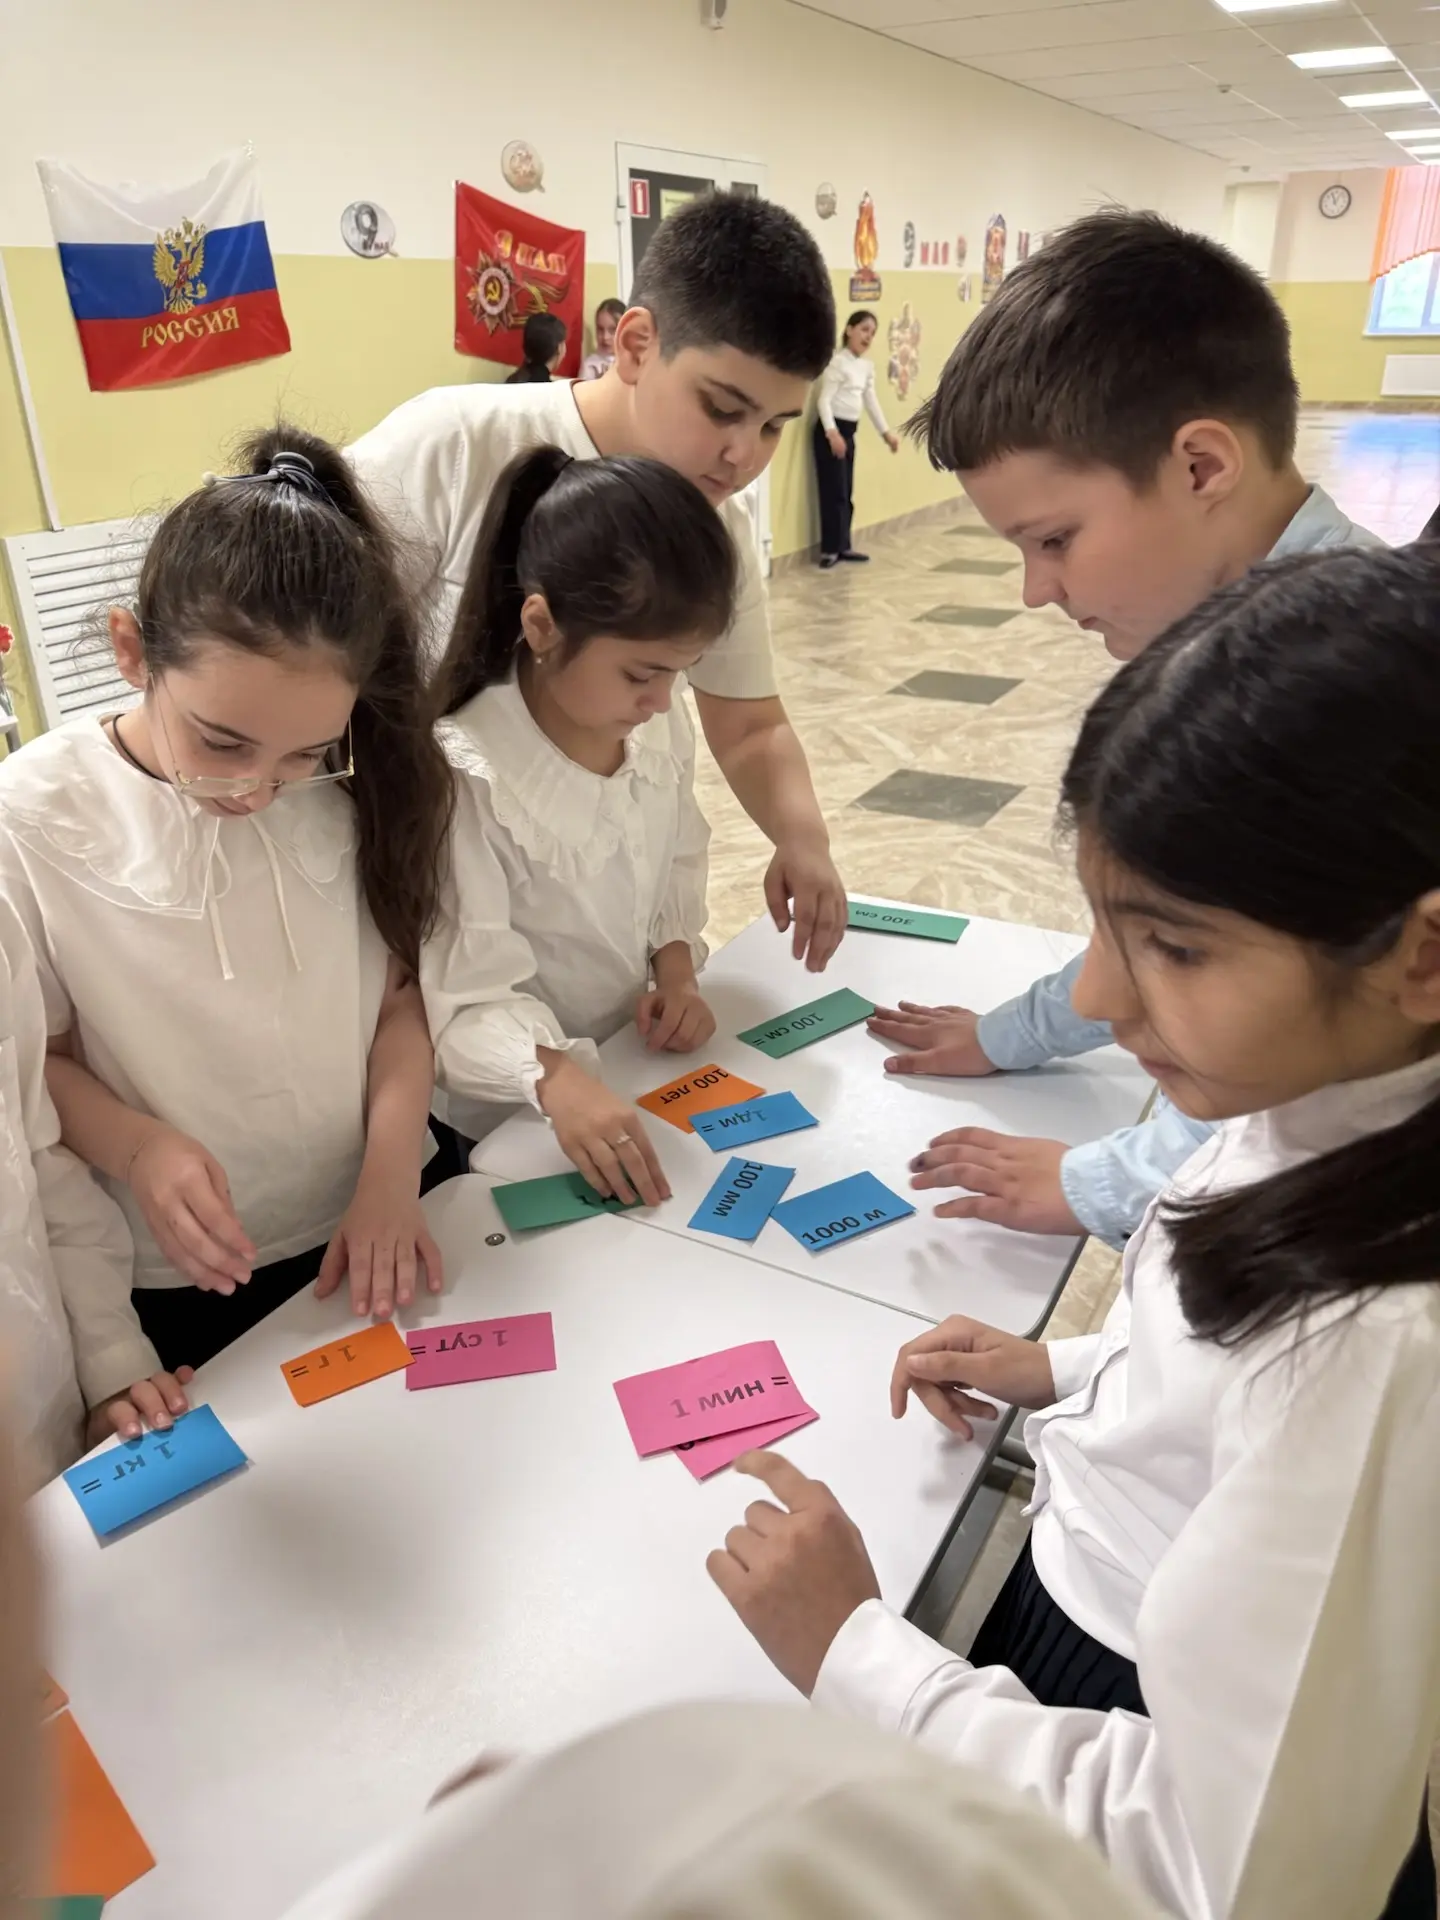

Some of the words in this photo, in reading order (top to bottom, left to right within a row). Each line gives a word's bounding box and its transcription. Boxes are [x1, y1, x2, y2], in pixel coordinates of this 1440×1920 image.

[355, 204, 378, 251] 9
[494, 230, 513, 259] 9
[141, 306, 240, 348] РОССИЯ
[855, 910, 878, 919] см
[881, 914, 915, 926] 300
[791, 1012, 824, 1031] 100
[764, 1027, 790, 1040] см
[692, 1068, 729, 1089] 100
[659, 1084, 690, 1105] лет
[733, 1161, 764, 1190] 100
[712, 1190, 741, 1217] мм
[801, 1215, 861, 1245] 1000
[863, 1208, 887, 1222] м
[435, 1332, 483, 1352] сут
[492, 1329, 509, 1347] 1
[338, 1344, 357, 1363] 1
[669, 1398, 691, 1418] 1
[698, 1379, 765, 1412] мин
[153, 1440, 175, 1460] 1
[112, 1454, 146, 1481] кг
